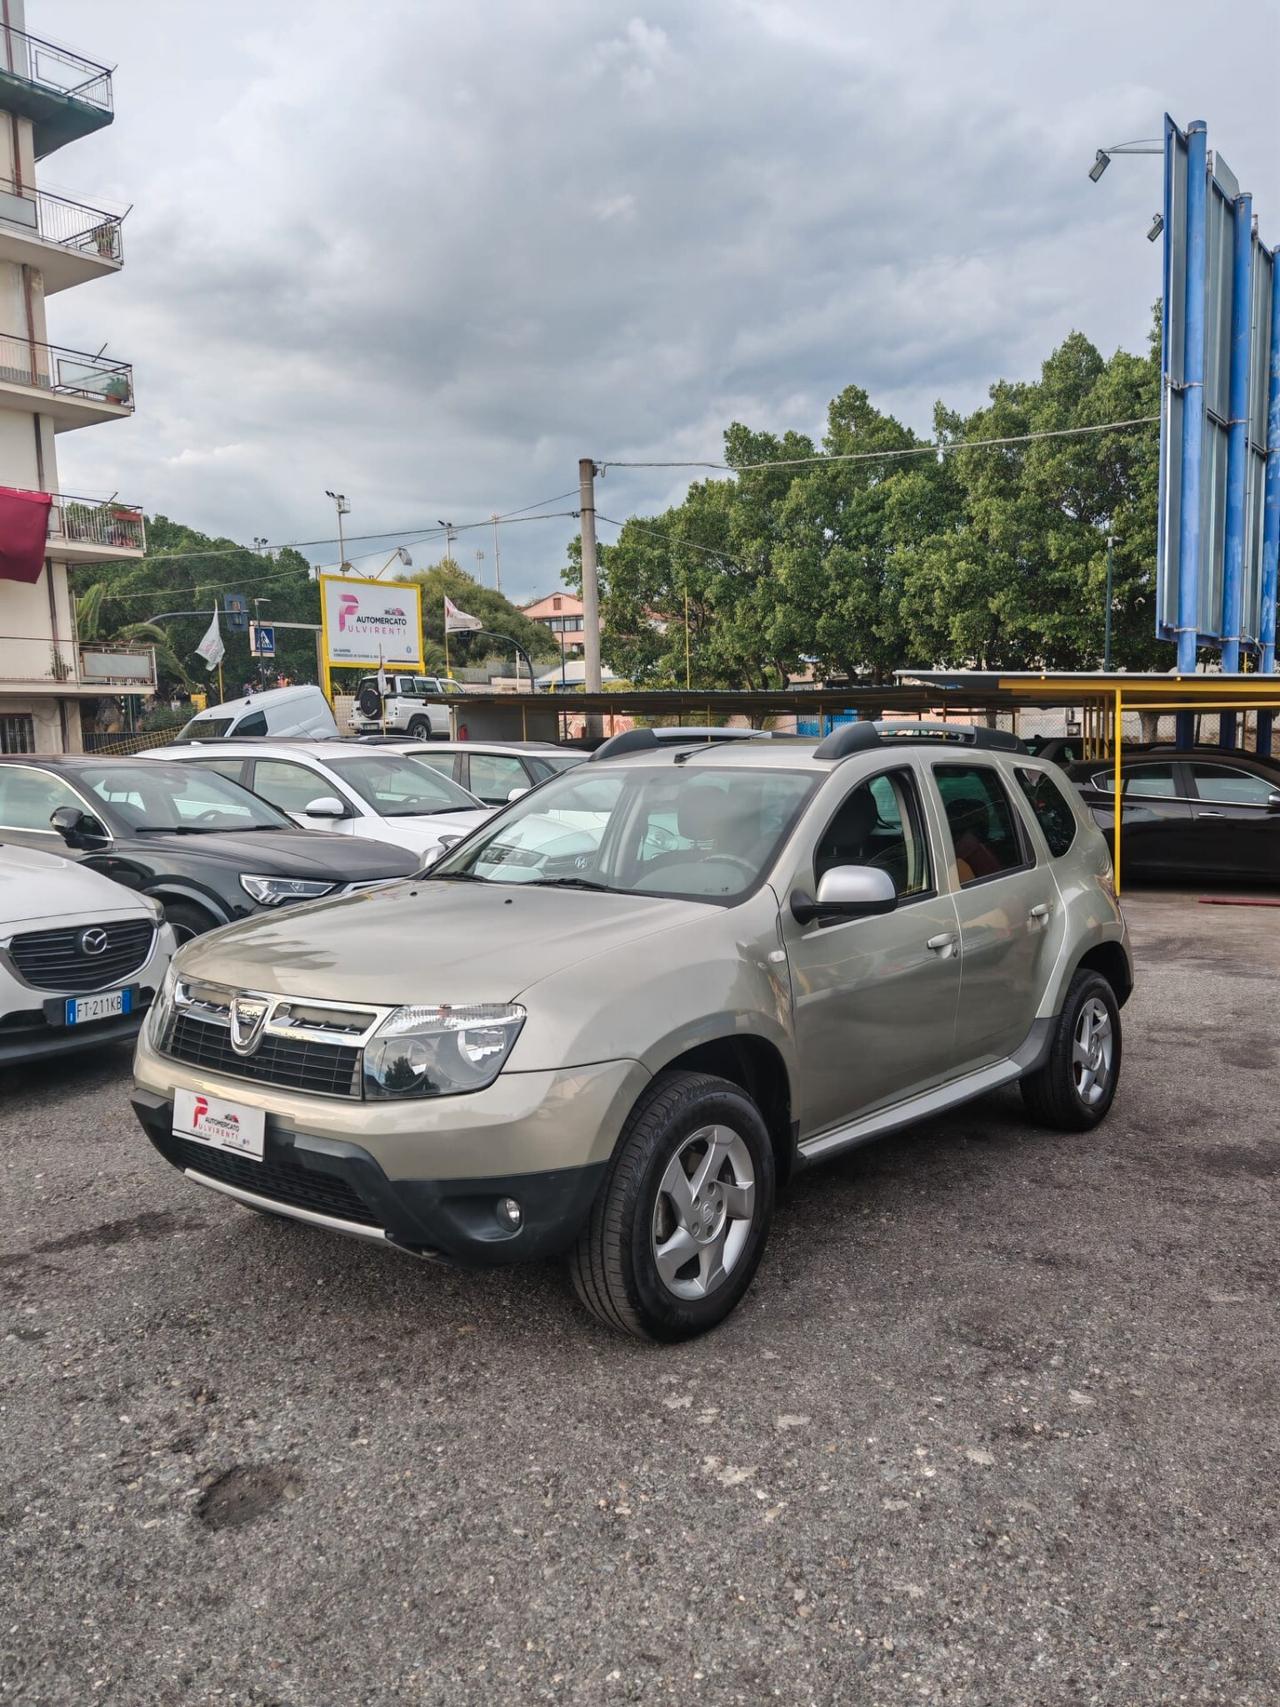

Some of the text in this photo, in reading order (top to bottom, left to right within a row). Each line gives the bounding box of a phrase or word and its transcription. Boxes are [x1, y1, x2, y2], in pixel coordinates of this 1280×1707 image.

[356, 616, 407, 625] AUTOMERCATO
[348, 625, 406, 635] ULVIRENTI
[205, 1116, 239, 1132] AUTOMERCATO
